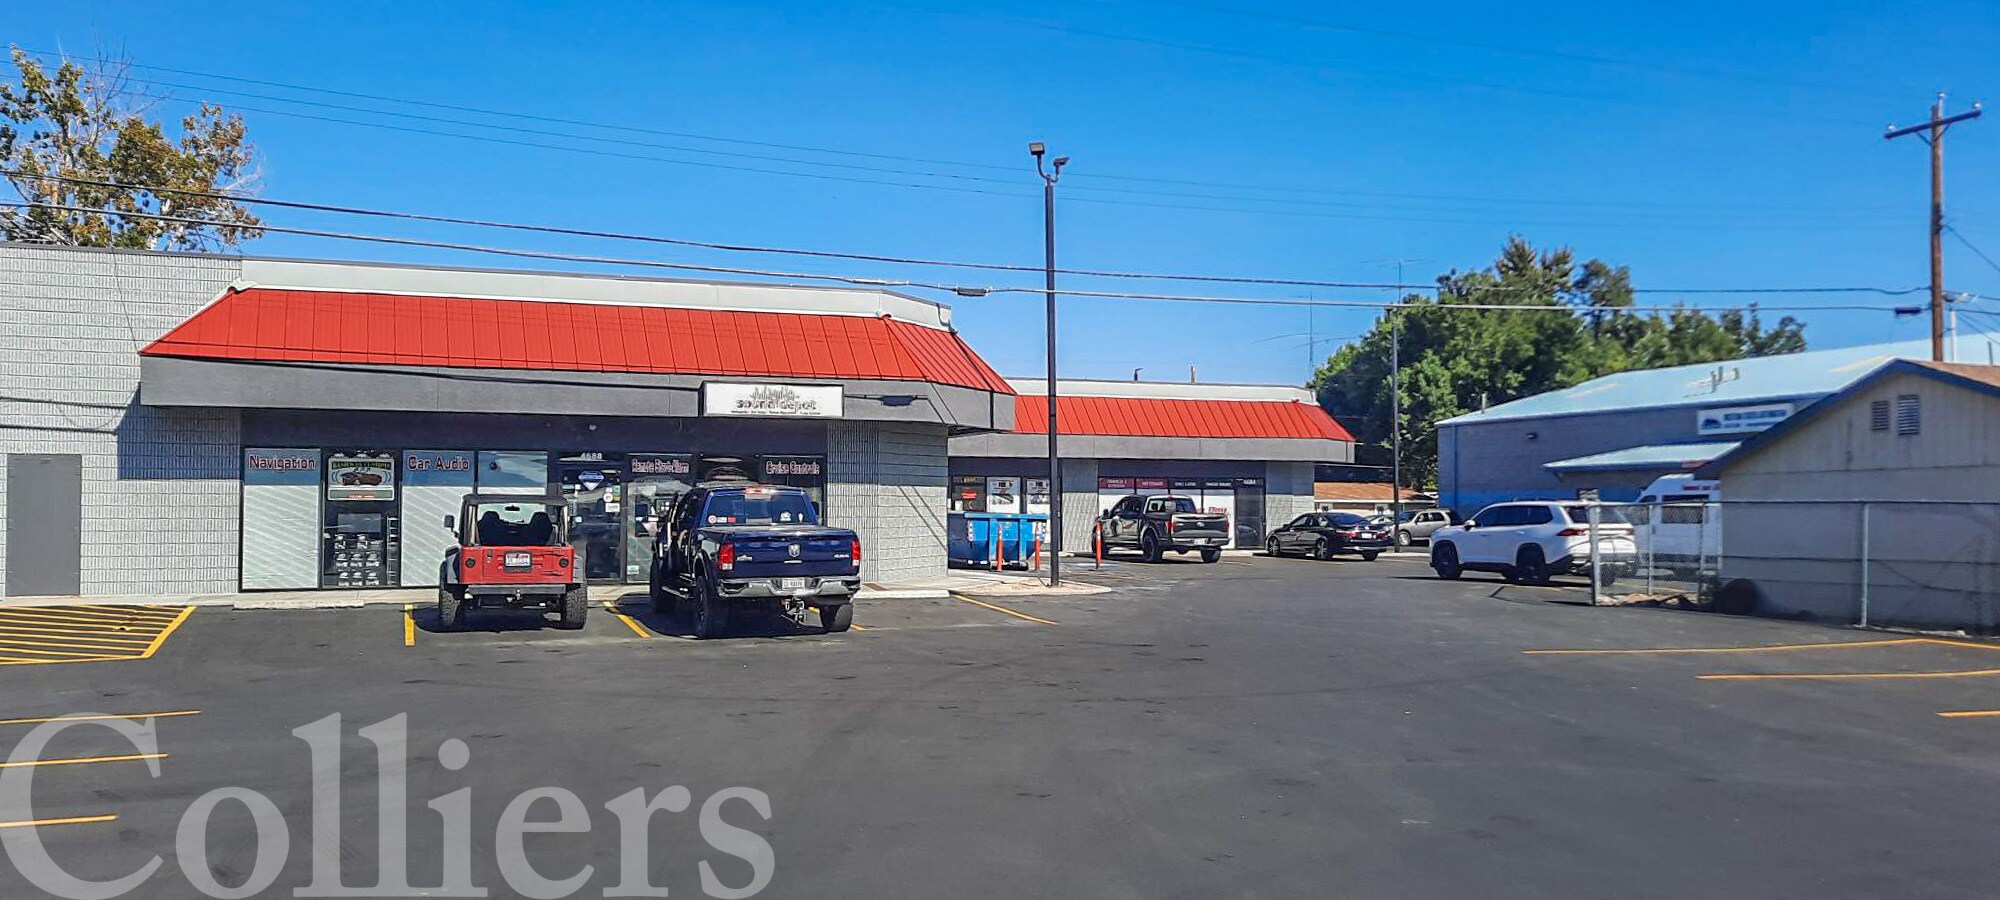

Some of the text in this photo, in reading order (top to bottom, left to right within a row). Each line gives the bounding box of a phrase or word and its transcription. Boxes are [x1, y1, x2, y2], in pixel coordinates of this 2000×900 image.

[248, 454, 316, 474] Navigation
[408, 455, 431, 471] Car
[435, 455, 470, 472] Audio
[766, 460, 821, 476] Cruise Controls
